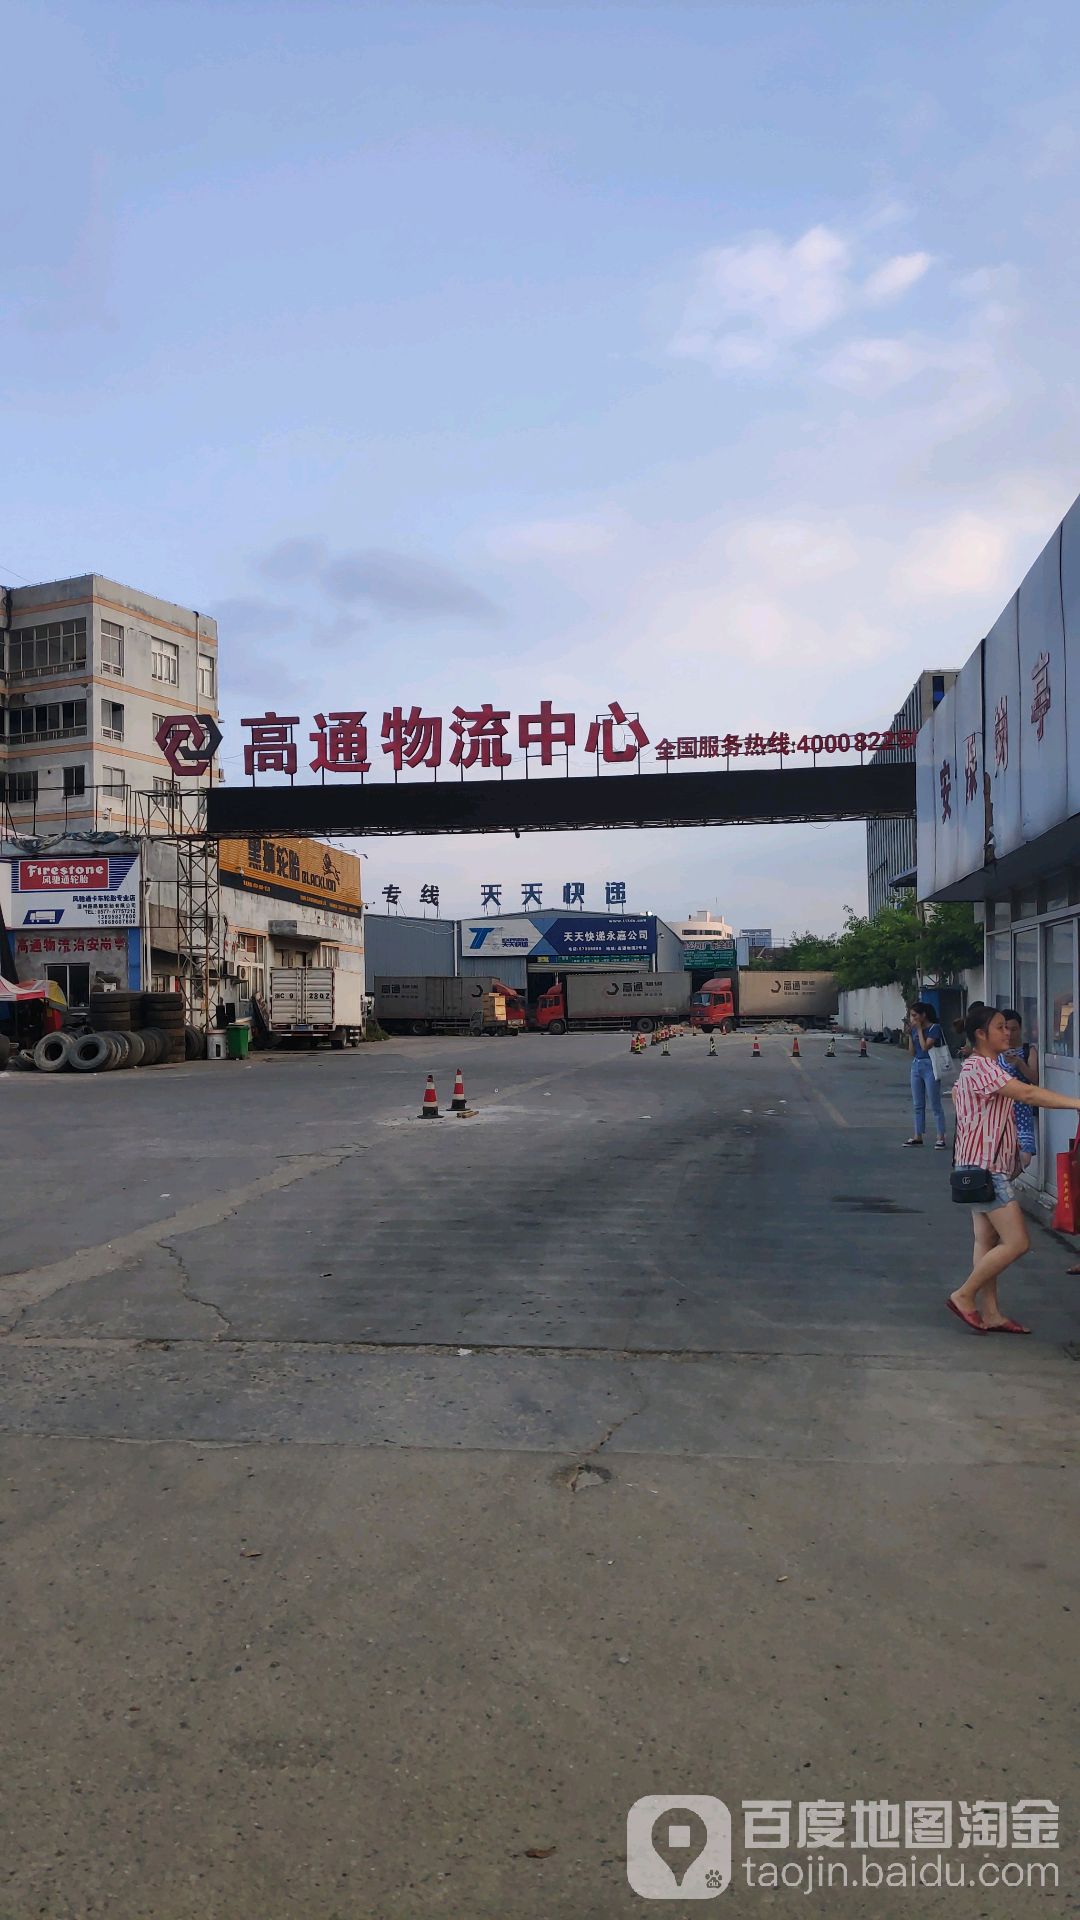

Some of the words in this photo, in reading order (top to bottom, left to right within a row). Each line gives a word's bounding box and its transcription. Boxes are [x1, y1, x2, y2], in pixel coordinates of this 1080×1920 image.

[240, 700, 650, 775] 高通物流中心
[27, 865, 104, 877] Firestone
[42, 875, 89, 885] 风驰通轮胎
[382, 884, 440, 906] 专线
[481, 882, 627, 905] 天天快递
[563, 930, 648, 942] 天天快递永嘉公司
